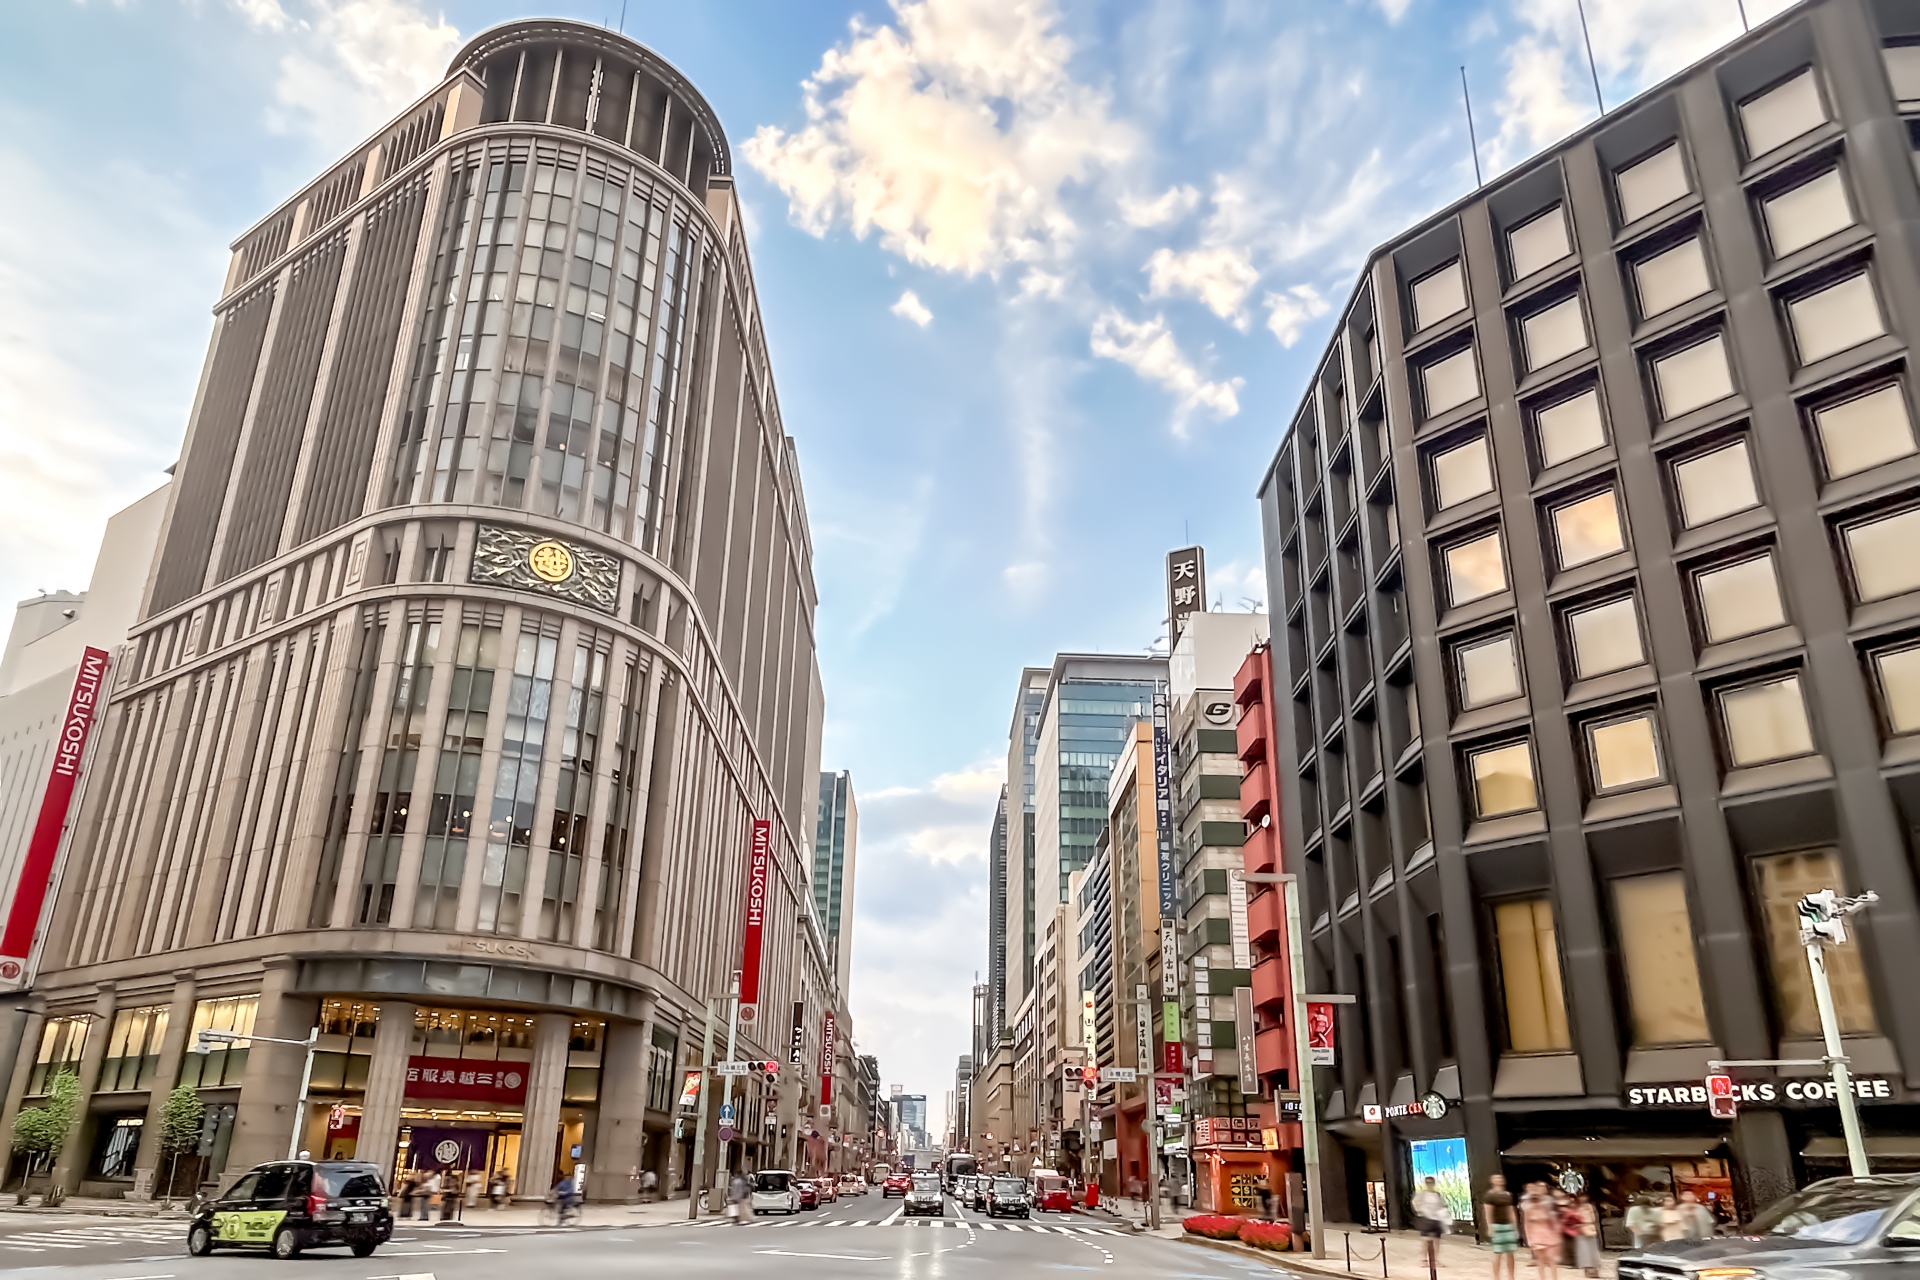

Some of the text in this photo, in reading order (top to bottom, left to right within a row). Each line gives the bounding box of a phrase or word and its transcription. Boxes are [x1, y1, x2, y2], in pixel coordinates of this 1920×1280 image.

[55, 654, 103, 776] MITSUKOSHI
[748, 826, 768, 926] MITSUKOSHI
[823, 1018, 834, 1075] MITSUKOSH
[1385, 1102, 1423, 1118] PONTE CEN
[1629, 1083, 1776, 1105] STARBCKS
